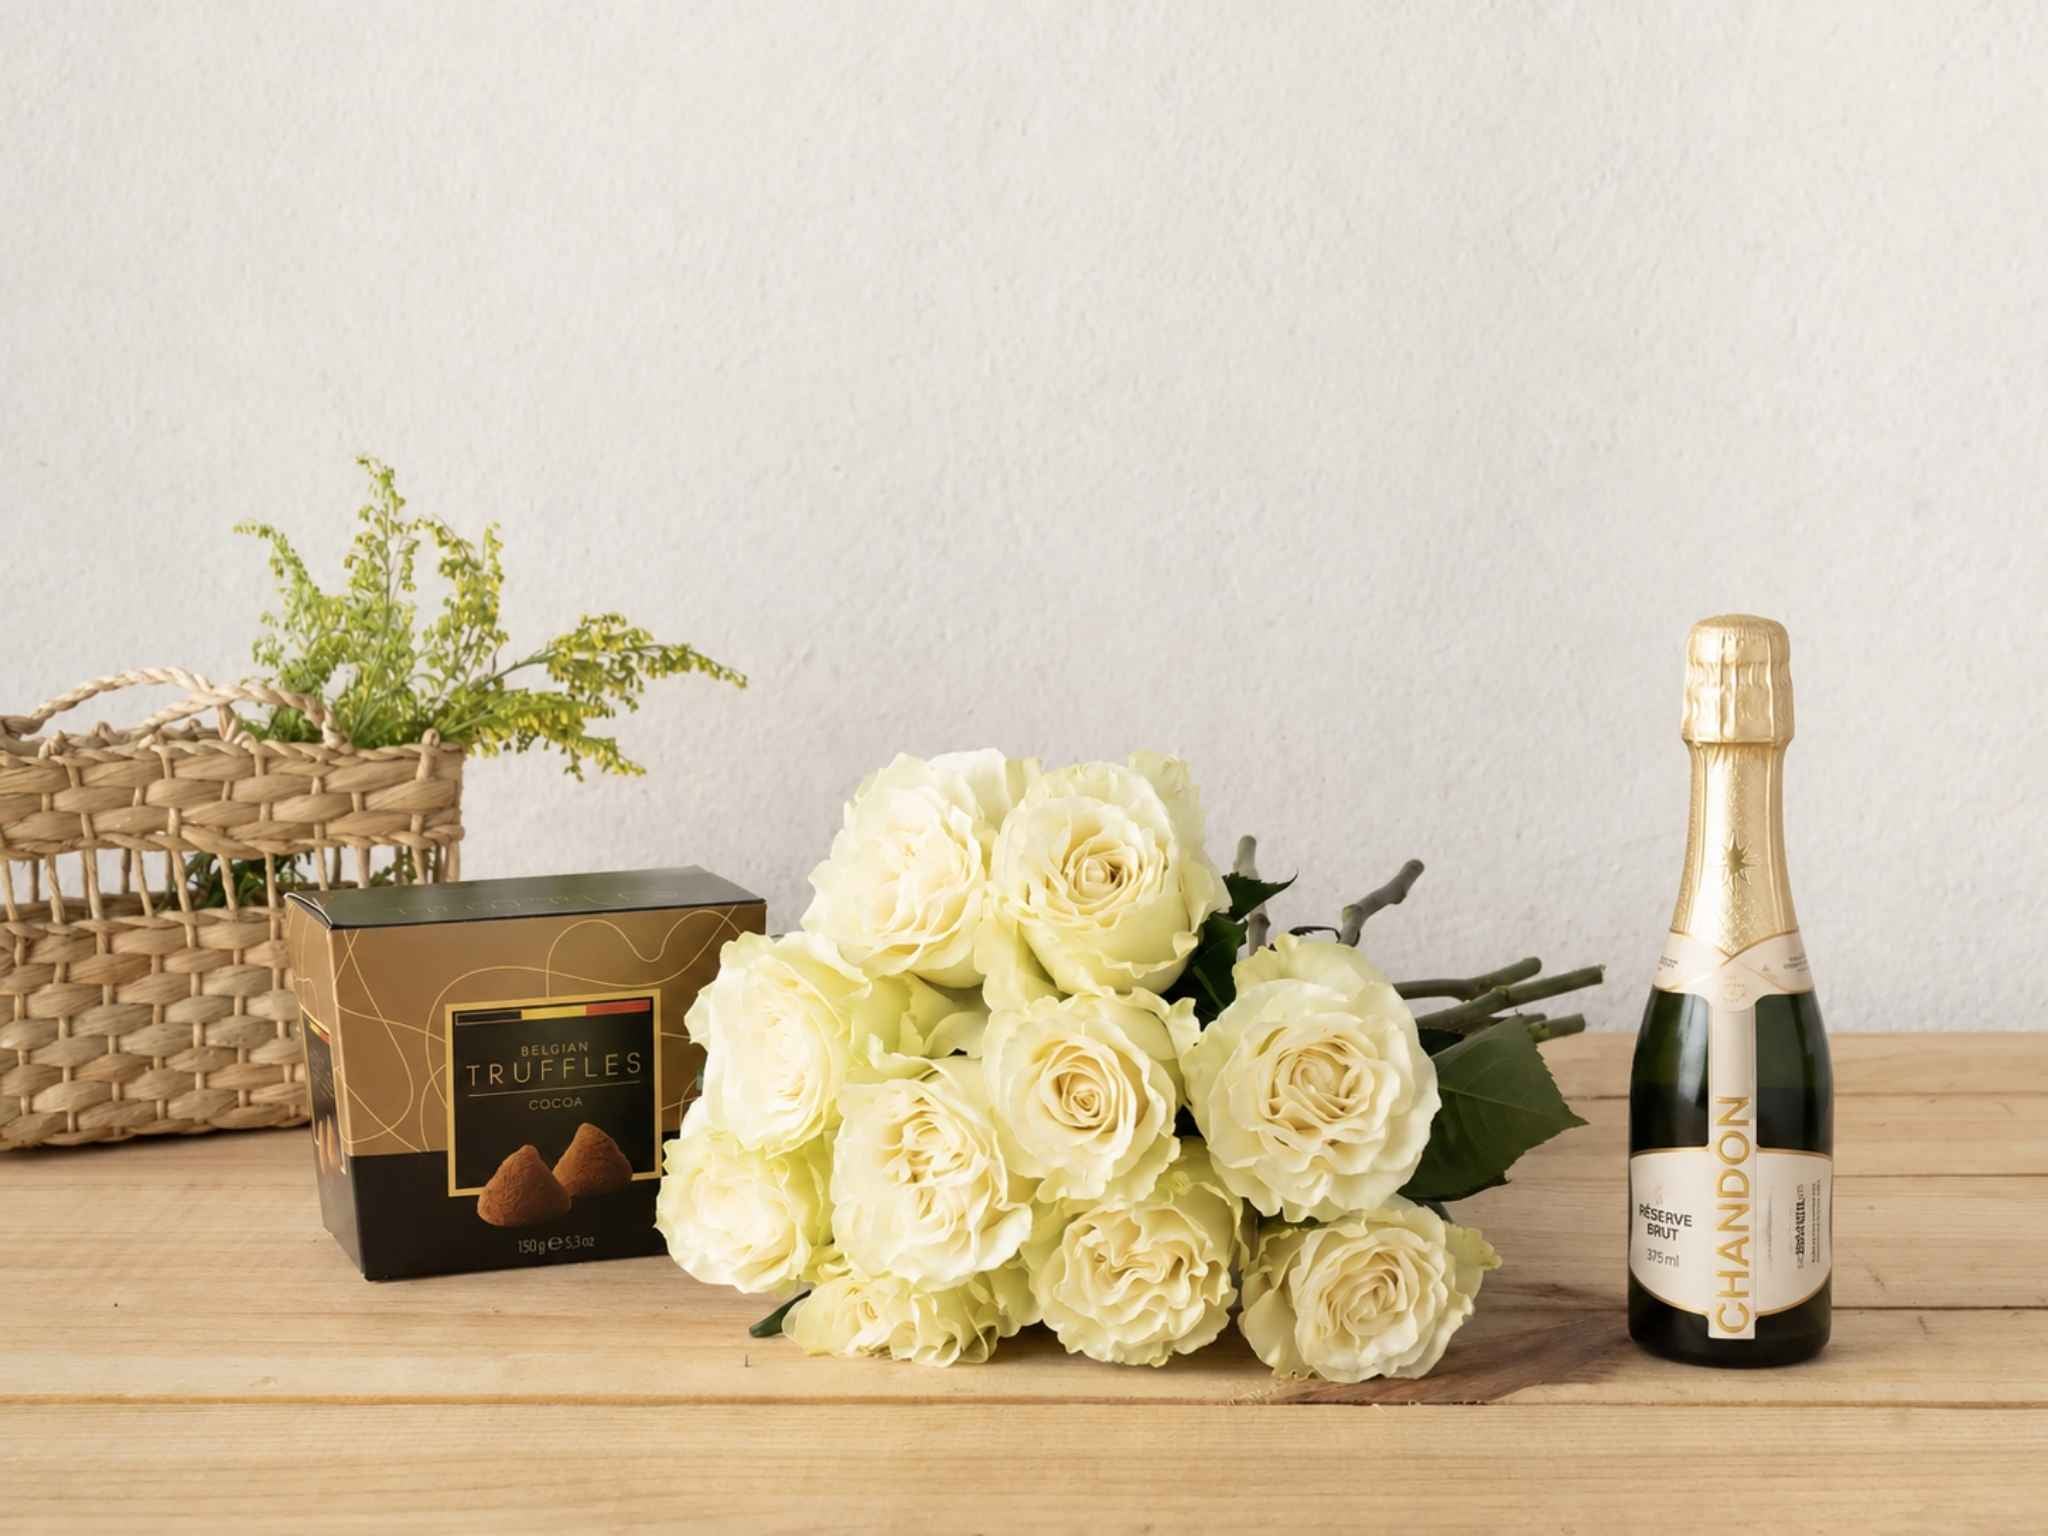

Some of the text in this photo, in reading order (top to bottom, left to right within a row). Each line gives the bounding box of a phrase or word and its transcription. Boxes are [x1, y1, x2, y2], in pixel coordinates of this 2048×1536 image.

[521, 1041, 589, 1056] BELGIAN
[466, 1052, 641, 1087] TRUFFLES
[528, 1097, 584, 1111] COCOA
[1639, 1203, 1693, 1227] RÉSERVE
[1715, 1095, 1750, 1333] CHANDON
[1647, 1223, 1679, 1242] BRUT
